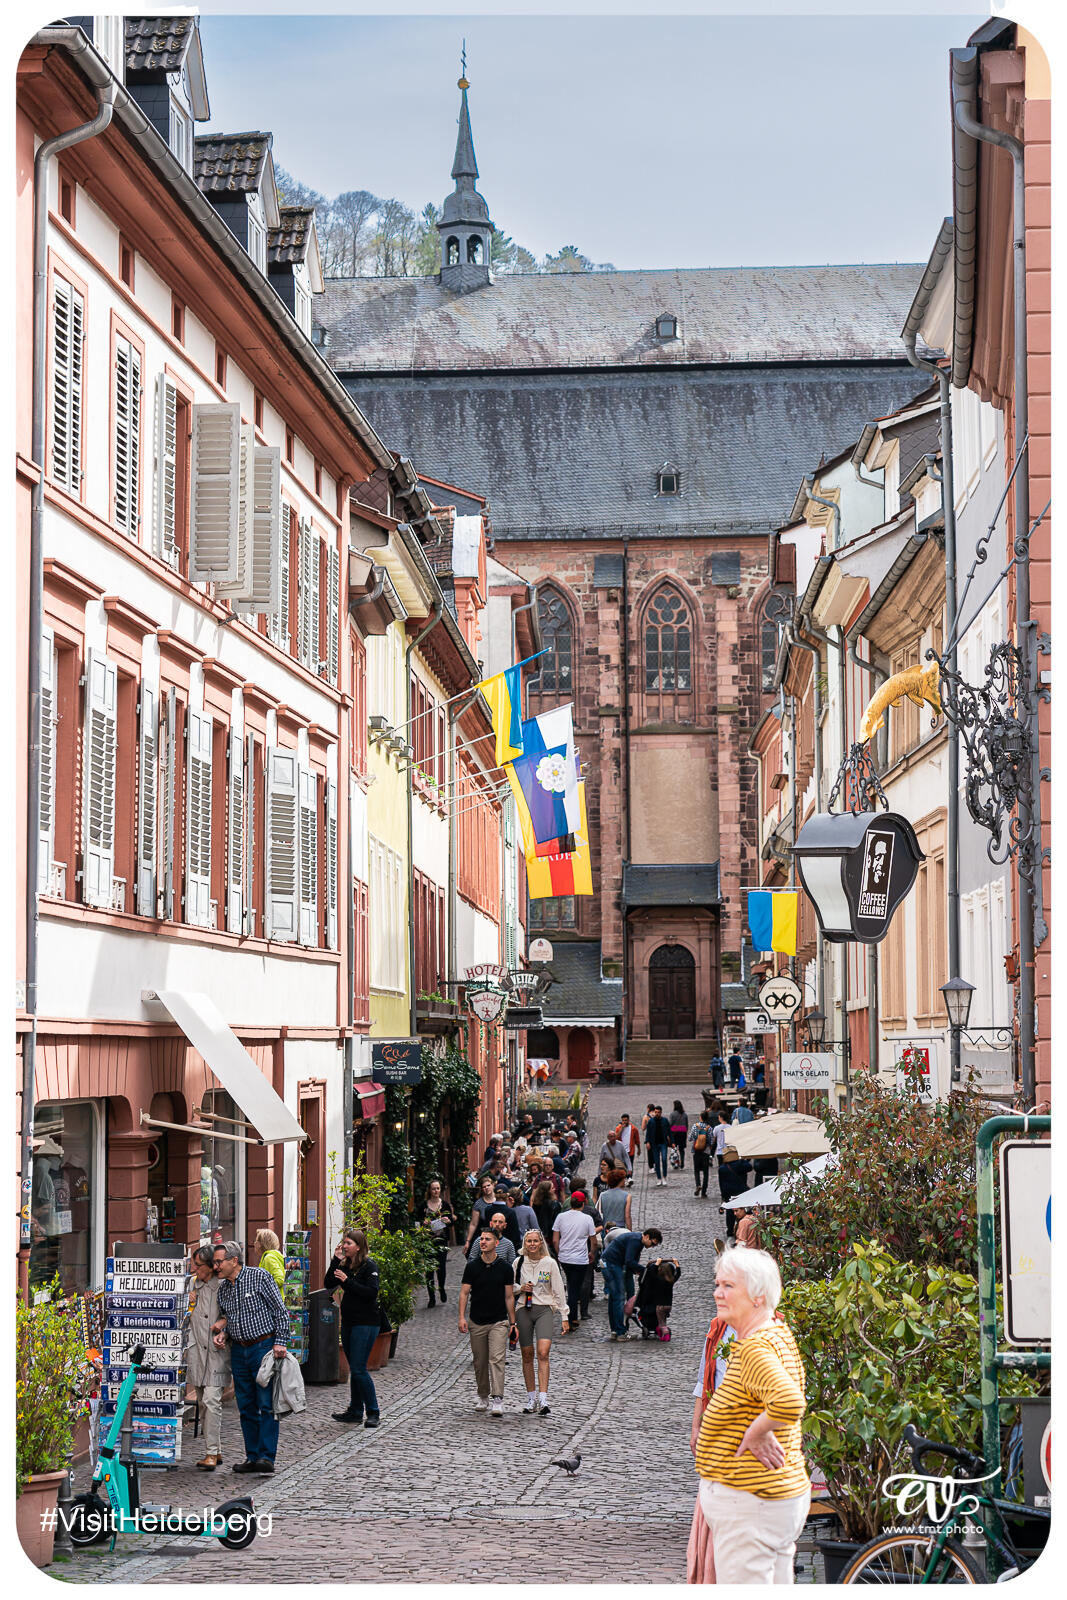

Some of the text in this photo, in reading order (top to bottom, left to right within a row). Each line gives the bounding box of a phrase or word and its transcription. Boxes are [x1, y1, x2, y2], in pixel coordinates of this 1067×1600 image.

[861, 892, 887, 907] COFFEE
[860, 905, 885, 916] FELLOWS
[466, 964, 506, 979] HOTEL
[115, 1260, 172, 1274] HEIDELBERG
[119, 1277, 176, 1291] HEIDELWOOD
[112, 1297, 169, 1310] Biergarten
[123, 1317, 171, 1328] Heidelberg
[111, 1332, 168, 1345] BIERGARTEN
[155, 1388, 177, 1401] OFF
[109, 1484, 120, 1513] TIER
